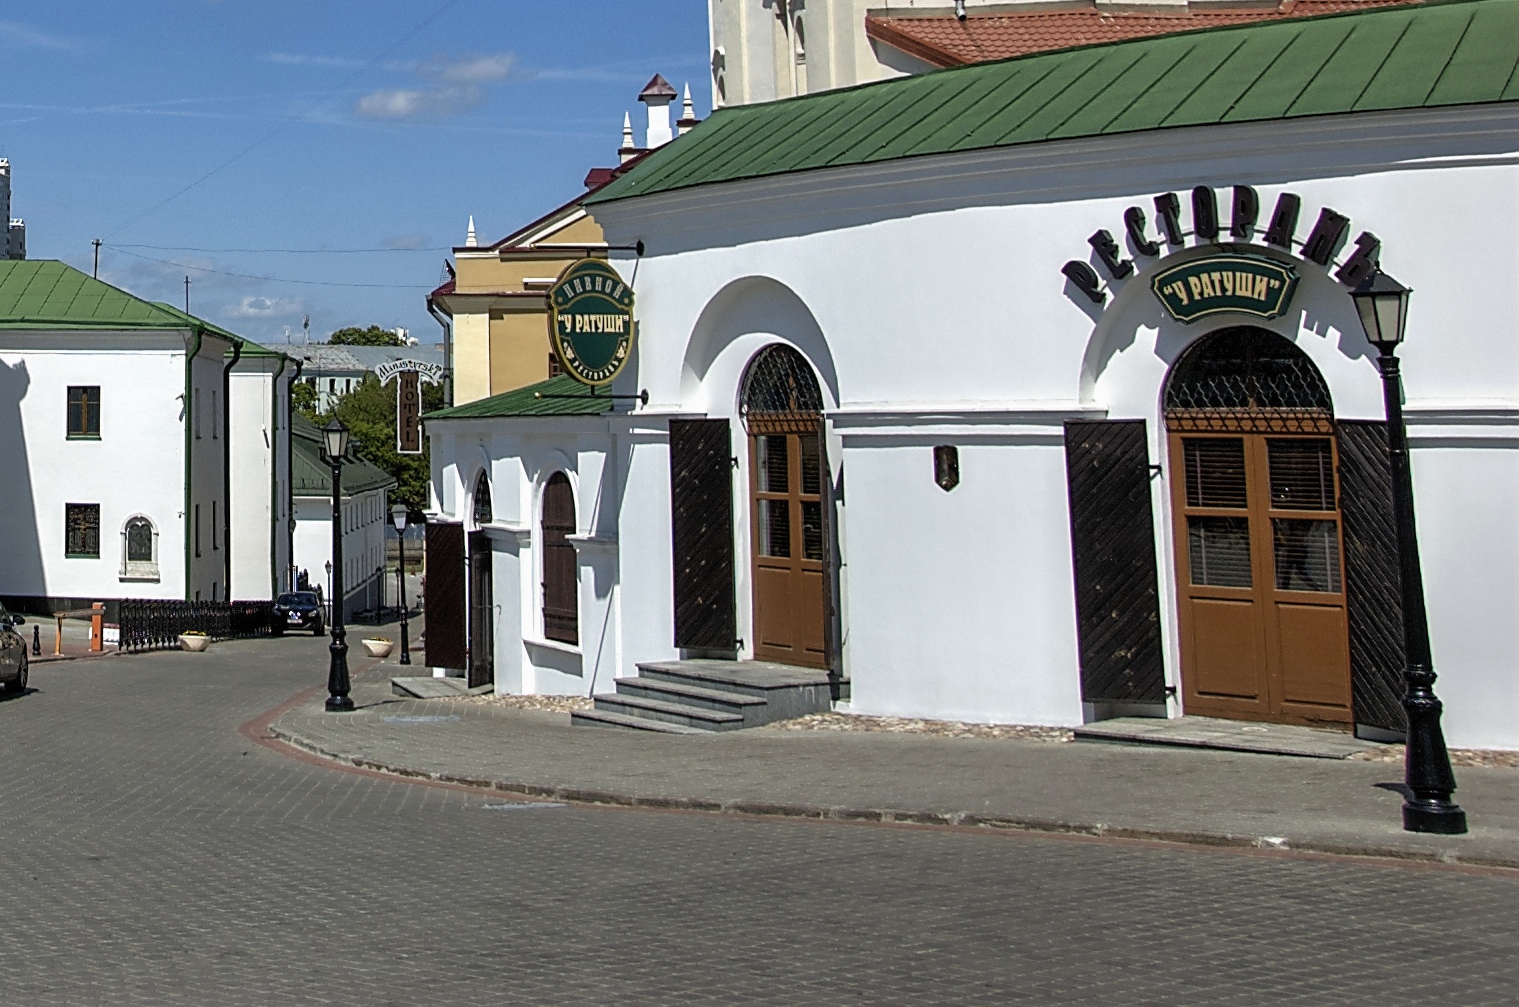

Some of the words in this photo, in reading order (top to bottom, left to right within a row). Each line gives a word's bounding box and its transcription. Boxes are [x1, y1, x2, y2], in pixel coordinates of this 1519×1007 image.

[1061, 184, 1381, 304] РЕСТОРАНЪ
[562, 276, 625, 299] ПИВНОЙ
[404, 379, 416, 443] HOTEL
